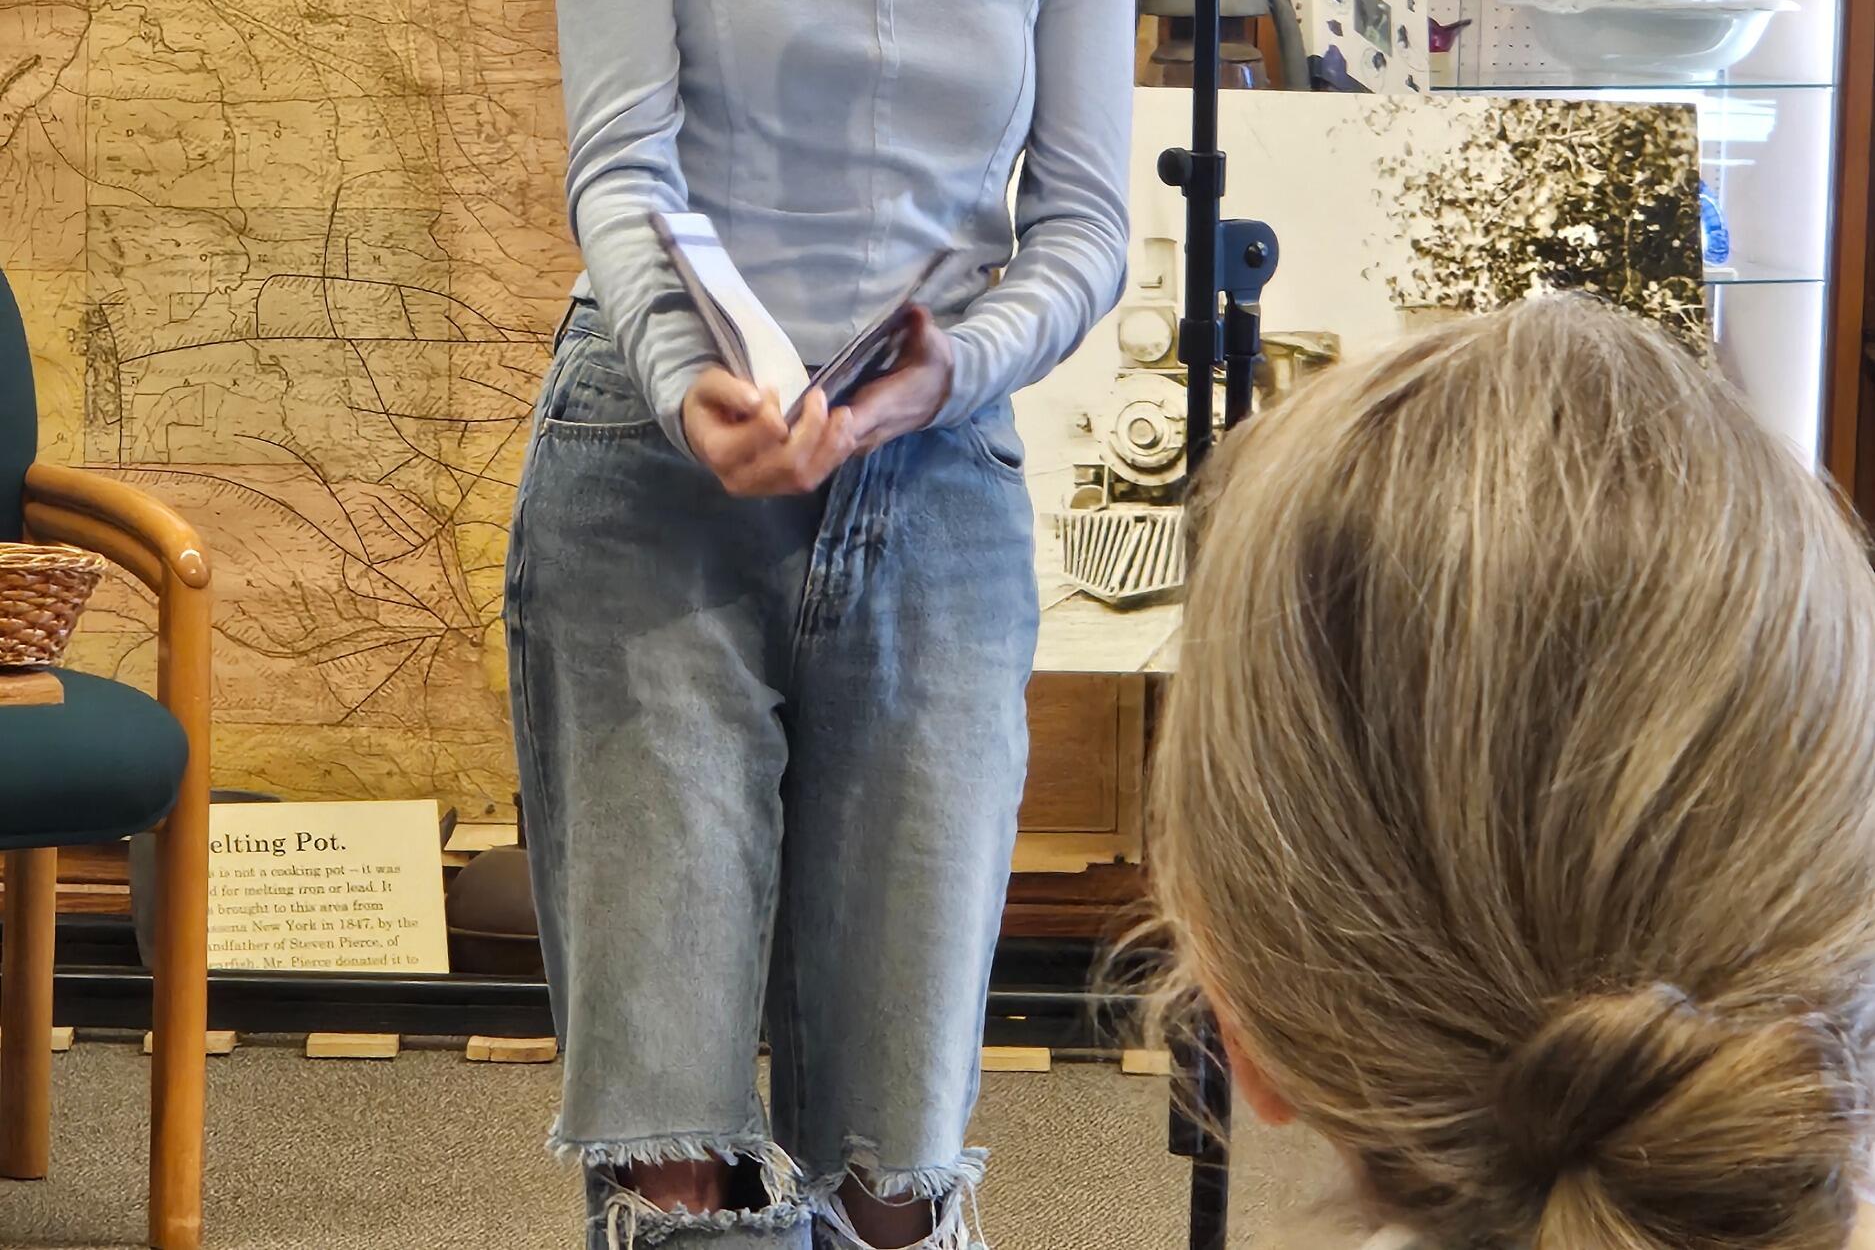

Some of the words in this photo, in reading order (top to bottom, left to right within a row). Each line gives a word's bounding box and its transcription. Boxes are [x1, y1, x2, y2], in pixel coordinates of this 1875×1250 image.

[296, 832, 346, 852] Pot.
[219, 869, 229, 878] is
[235, 868, 256, 878] not
[260, 870, 267, 878] a
[271, 864, 321, 878] cooking
[325, 866, 345, 879] pot
[362, 865, 371, 874] it
[222, 885, 238, 896] for
[245, 884, 294, 896] melting
[299, 884, 325, 895] iron
[329, 886, 341, 894] or
[382, 880, 392, 892] It
[218, 902, 268, 916] brought
[274, 904, 286, 914] to
[290, 902, 316, 914] this
[320, 904, 348, 912] area
[353, 900, 384, 911] from
[253, 920, 281, 932] New
[286, 919, 316, 932] York
[321, 921, 334, 930] in
[378, 918, 392, 931] by
[398, 917, 418, 928] the
[273, 939, 286, 950] of
[290, 937, 334, 949] Steven
[386, 935, 400, 947] of
[292, 956, 332, 968] Pierce
[335, 954, 387, 966] donated
[392, 954, 401, 965] it
[406, 954, 419, 964] to
